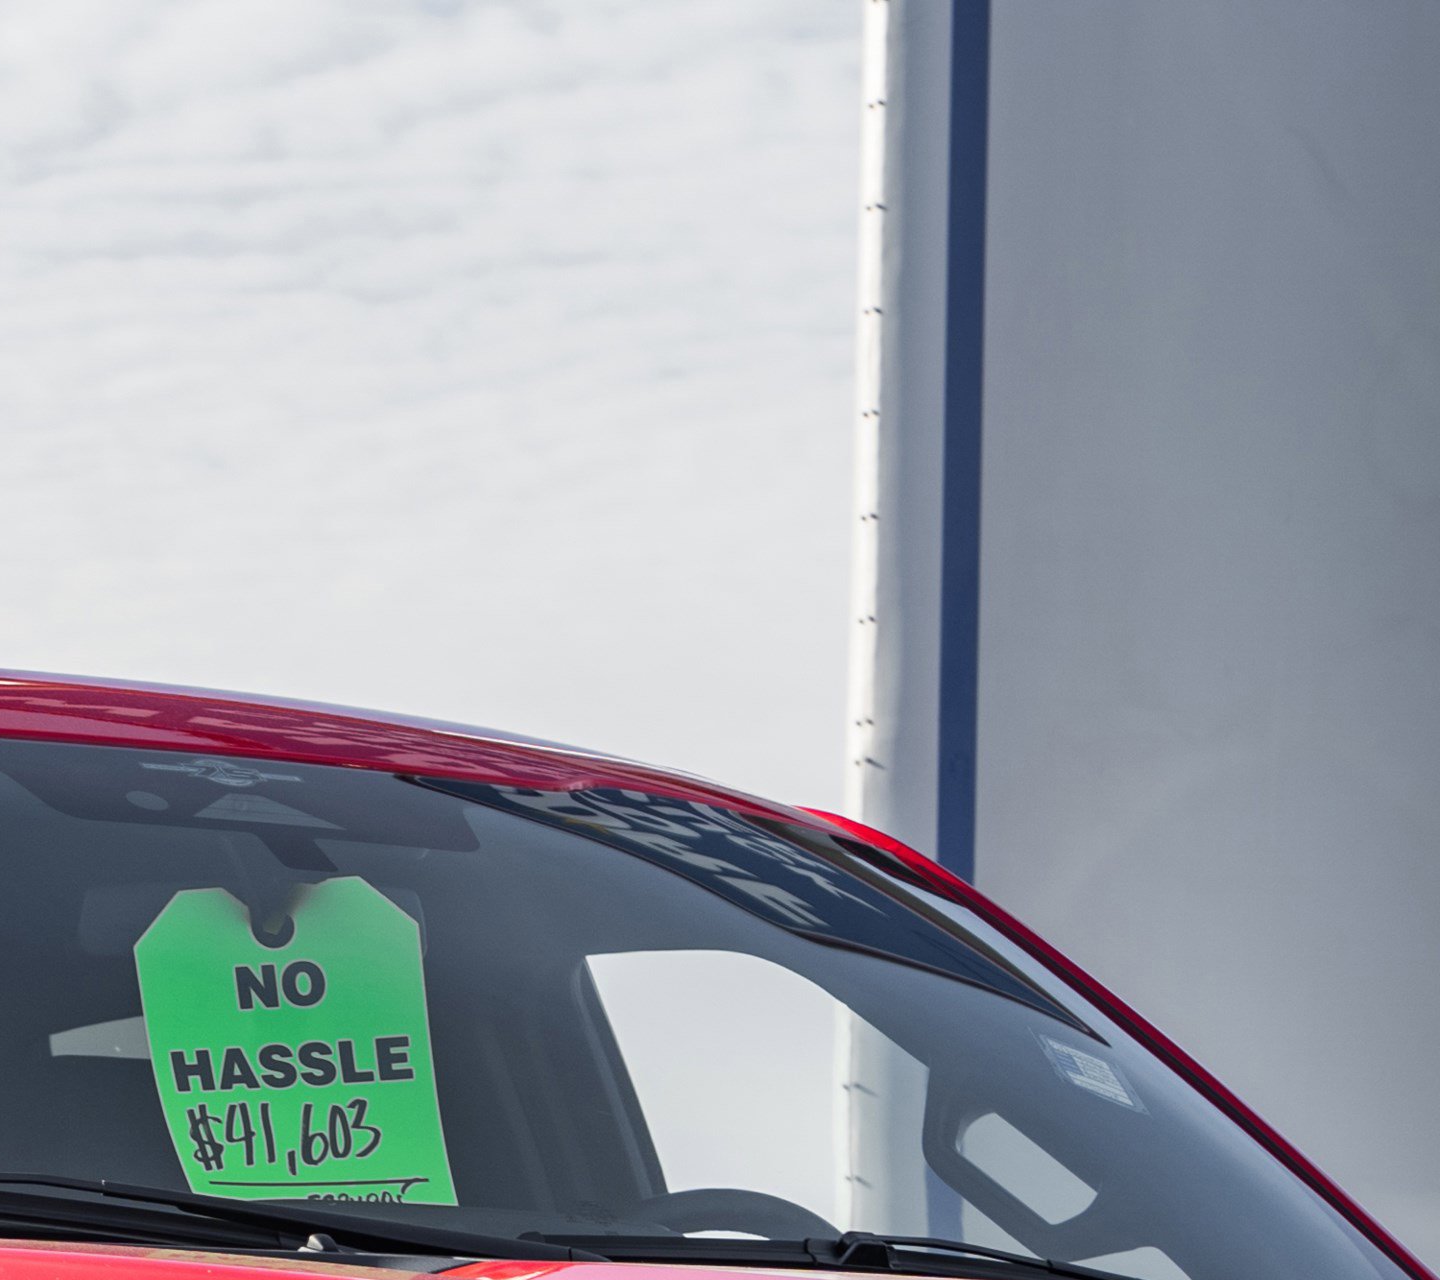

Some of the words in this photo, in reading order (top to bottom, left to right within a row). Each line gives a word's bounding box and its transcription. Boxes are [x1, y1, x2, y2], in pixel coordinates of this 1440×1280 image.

[233, 959, 327, 1011] NO
[169, 1035, 416, 1093] HASSLE
[186, 1098, 382, 1177] $41,603
